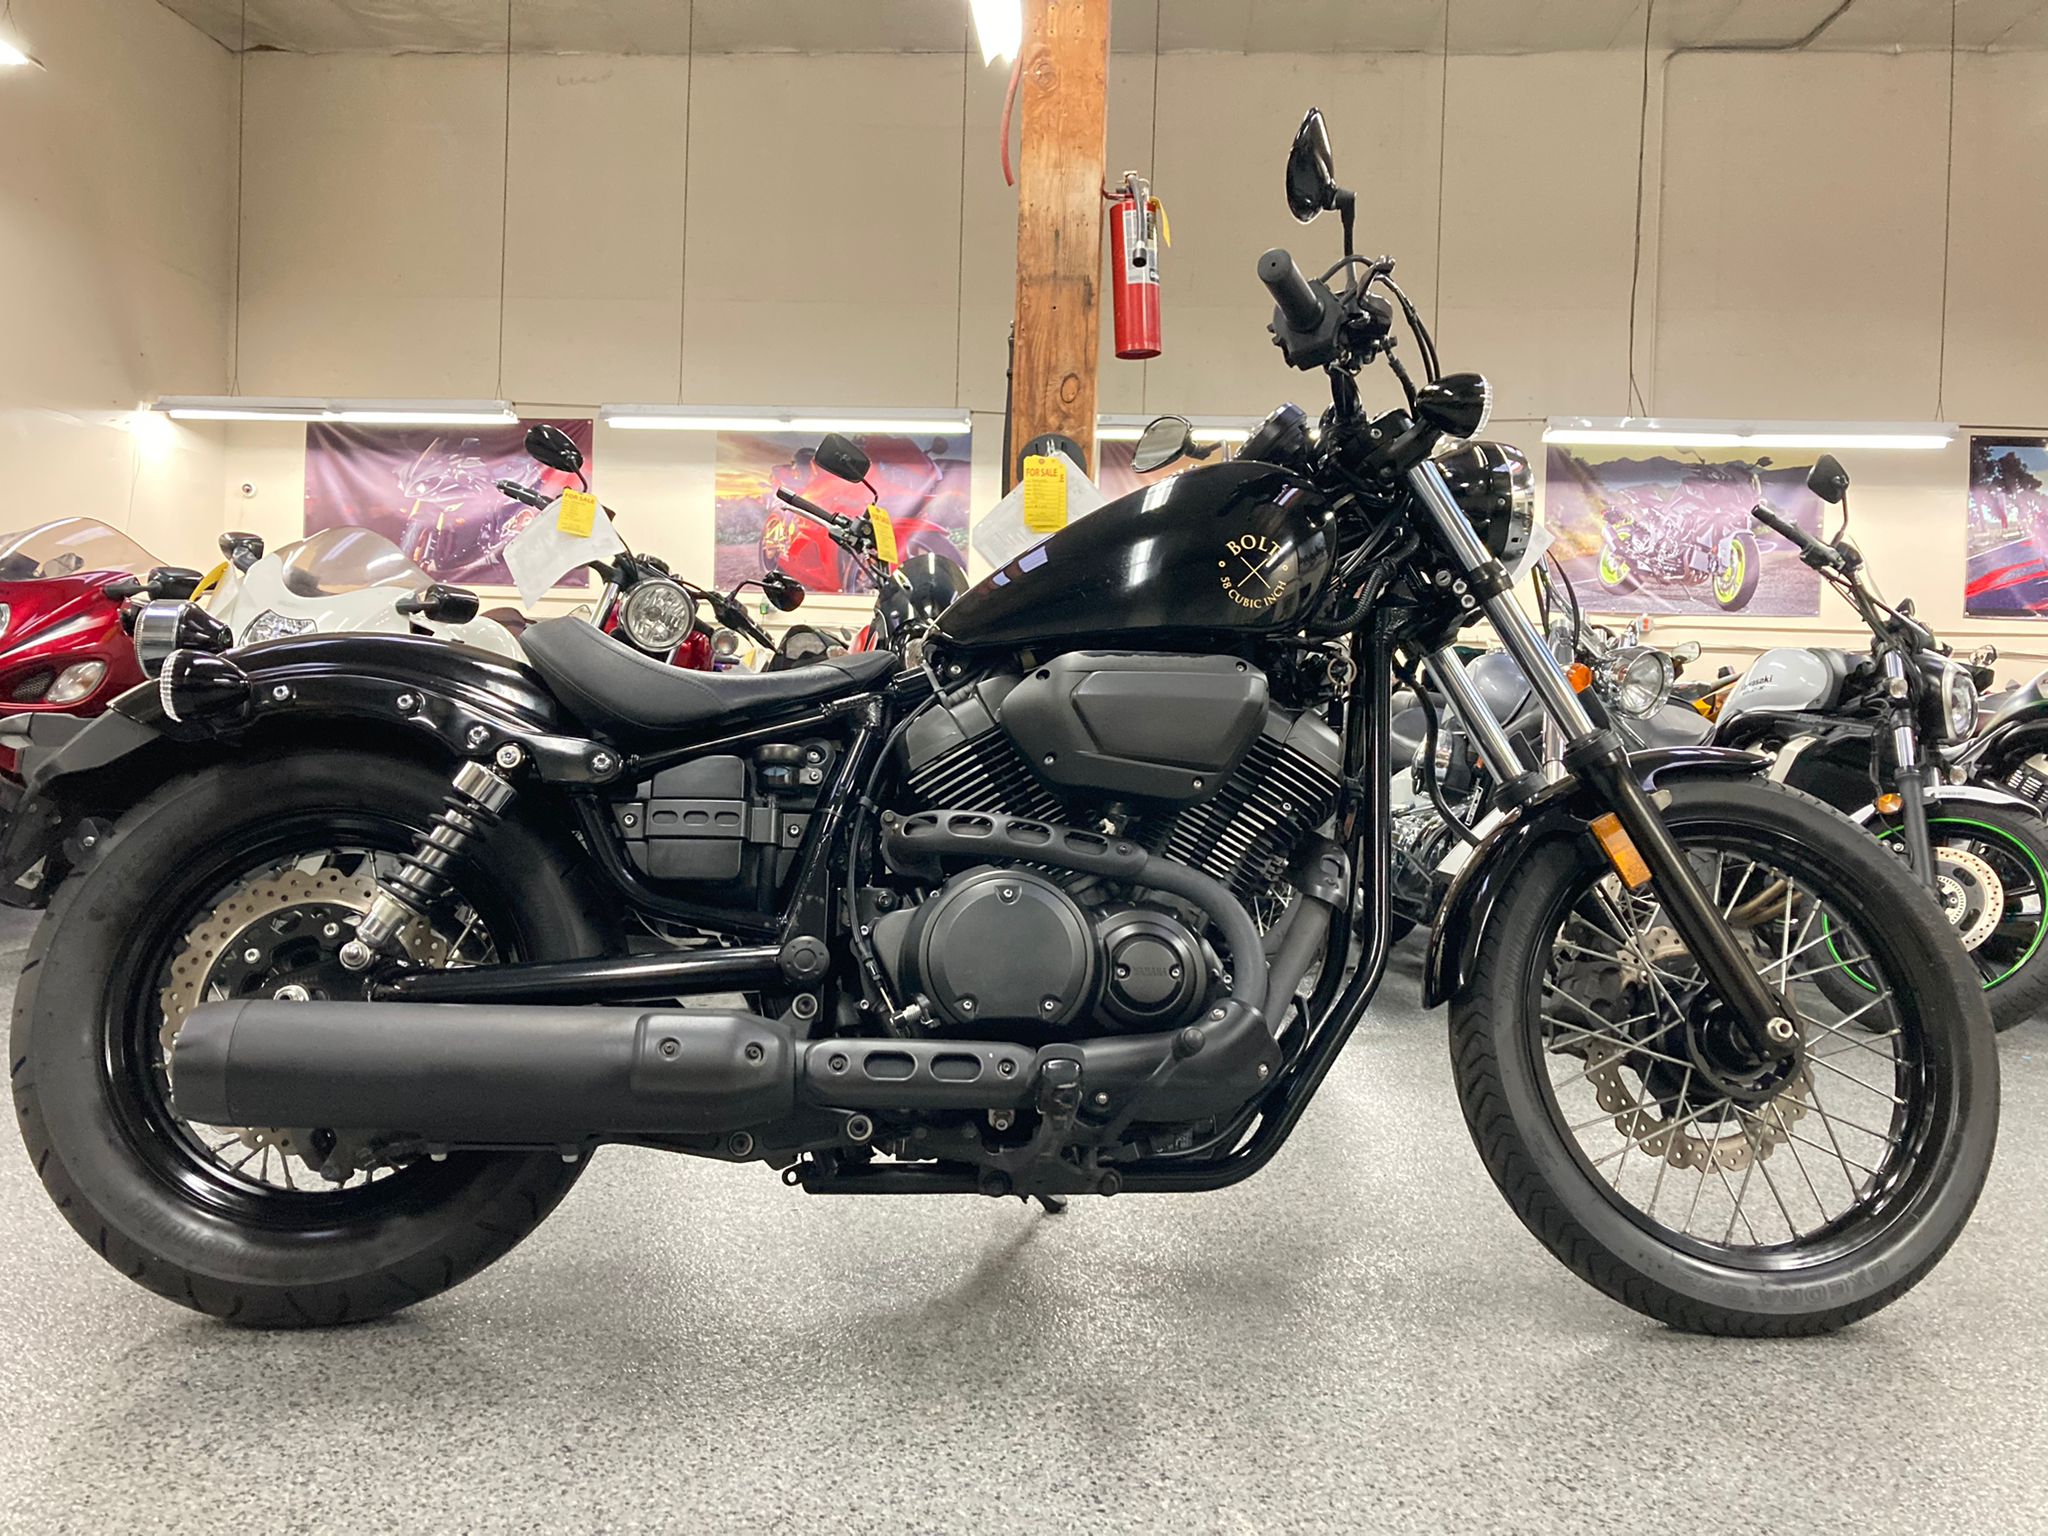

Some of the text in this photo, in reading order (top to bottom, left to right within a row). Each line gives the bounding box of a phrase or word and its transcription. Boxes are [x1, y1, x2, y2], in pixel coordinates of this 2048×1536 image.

[1026, 468, 1058, 477] FOR SALE
[579, 496, 595, 505] SALE
[1225, 534, 1281, 556] BOLT
[1220, 576, 1287, 609] 58 CUBIC INCH
